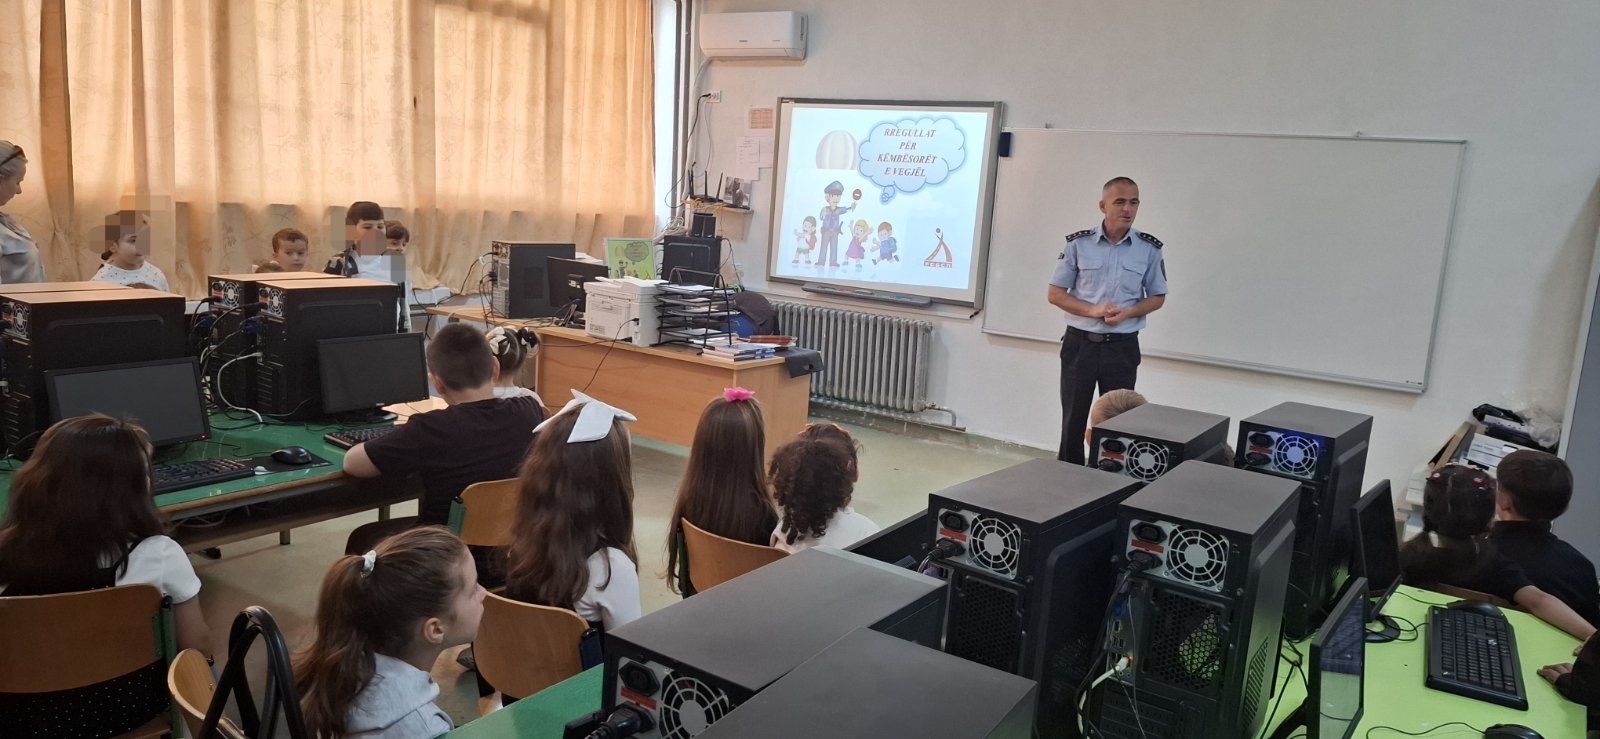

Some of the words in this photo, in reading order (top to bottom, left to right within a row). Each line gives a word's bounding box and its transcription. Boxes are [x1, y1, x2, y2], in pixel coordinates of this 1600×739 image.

[884, 128, 936, 138] RREGULLAT
[899, 140, 917, 150] PËR
[877, 153, 938, 164] KËMBËSORËT
[884, 167, 892, 175] E
[893, 167, 926, 177] VEGJËL
